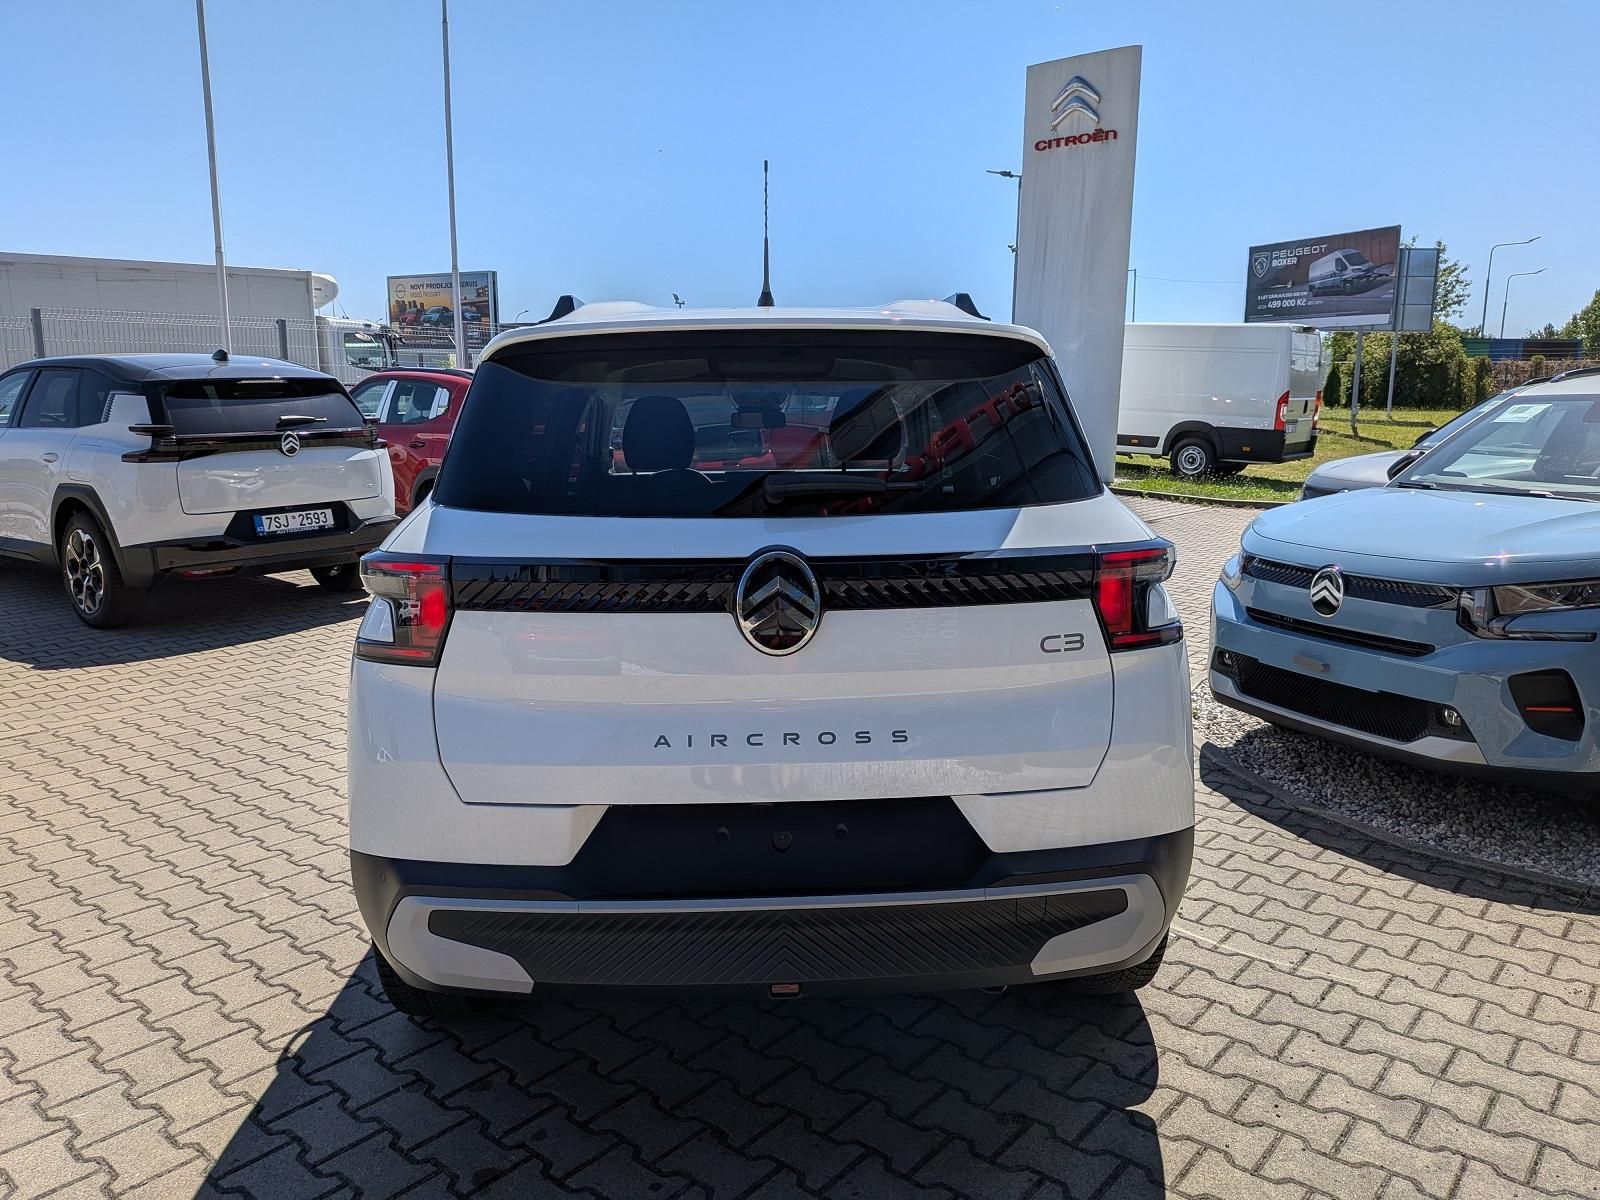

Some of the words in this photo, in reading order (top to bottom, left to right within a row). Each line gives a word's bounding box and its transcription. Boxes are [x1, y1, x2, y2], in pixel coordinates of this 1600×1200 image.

[1272, 244, 1328, 258] PEUGEOT
[1272, 257, 1298, 267] BOXER
[410, 281, 425, 290] NOVÝ
[1267, 300, 1281, 308] 499
[1282, 299, 1296, 307] 000
[1296, 298, 1307, 306] Kč
[265, 514, 290, 530] 7SJ
[298, 511, 328, 527] 2593
[1039, 632, 1085, 654] C3
[653, 730, 909, 748] AIRCROSS
